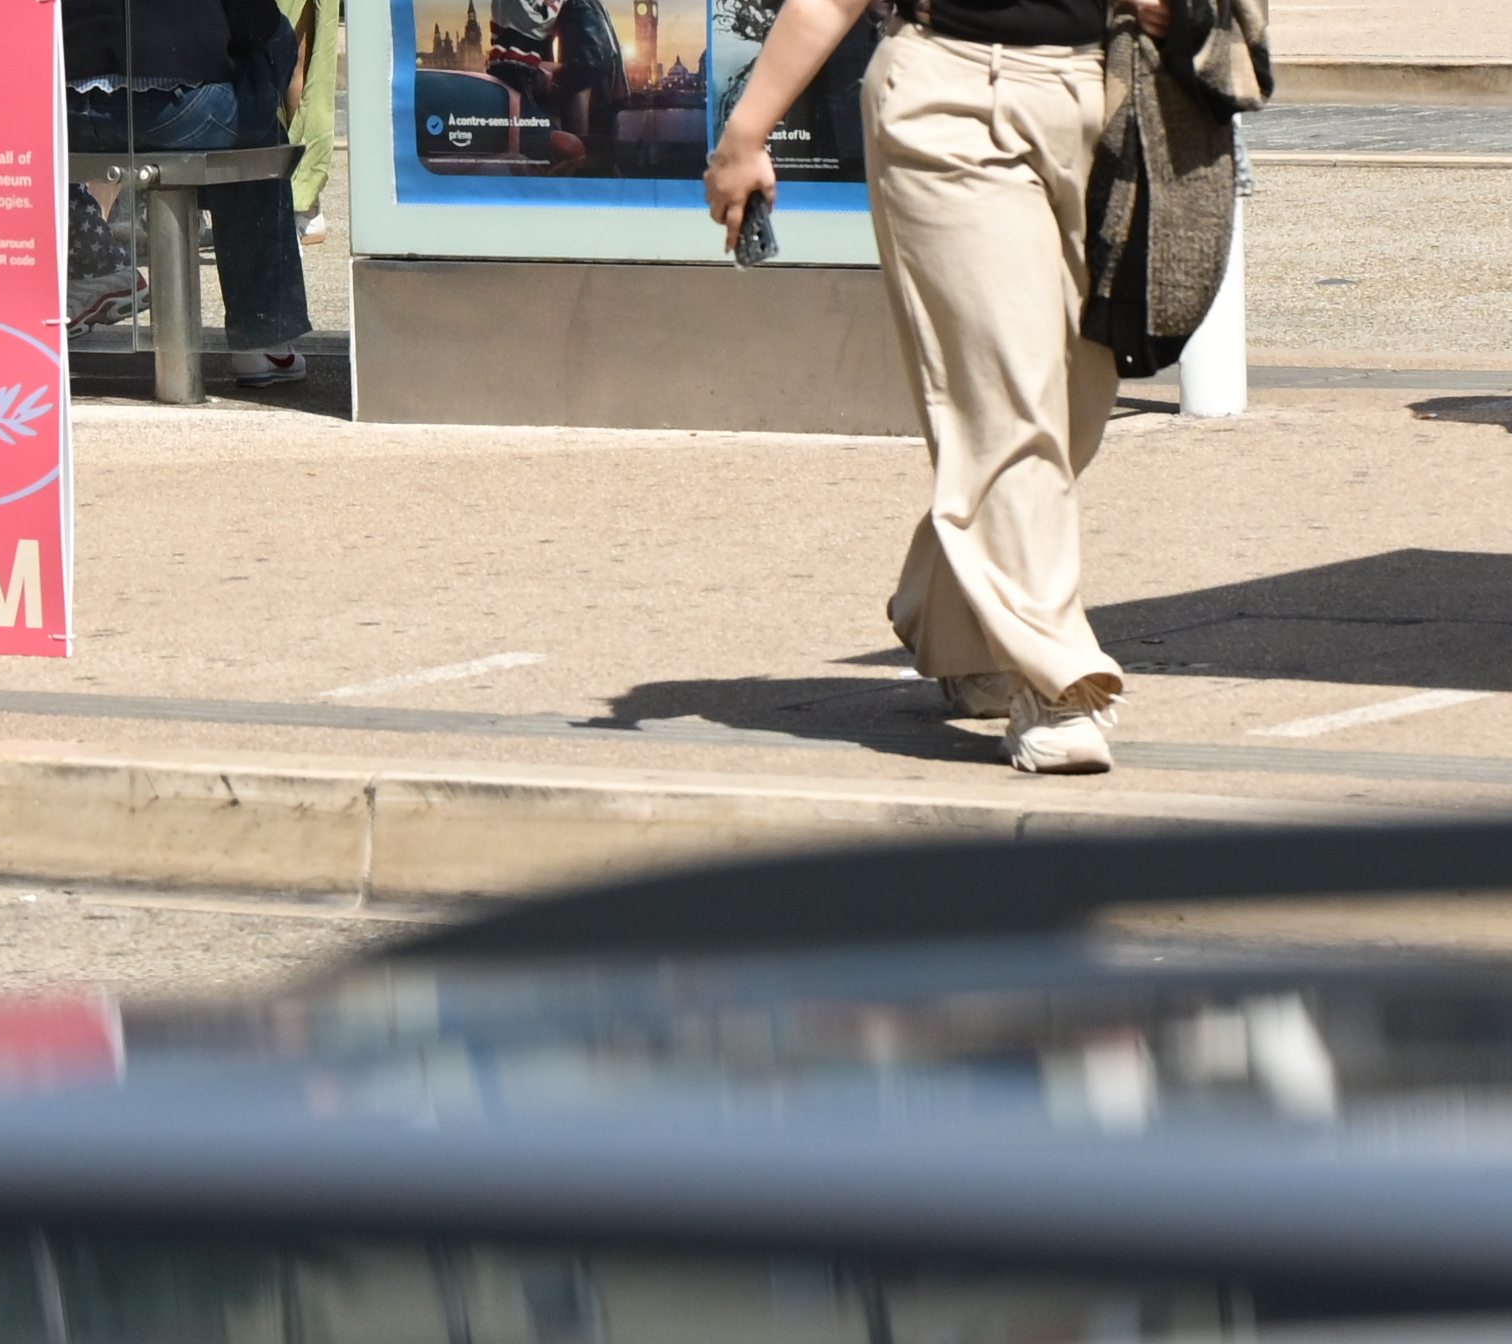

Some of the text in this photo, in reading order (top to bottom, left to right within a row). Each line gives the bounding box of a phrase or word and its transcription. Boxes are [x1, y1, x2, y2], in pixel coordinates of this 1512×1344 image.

[513, 116, 551, 128] Londres
[448, 130, 473, 143] prime
[788, 129, 798, 140] of
[798, 129, 811, 140] Us
[18, 151, 32, 164] of
